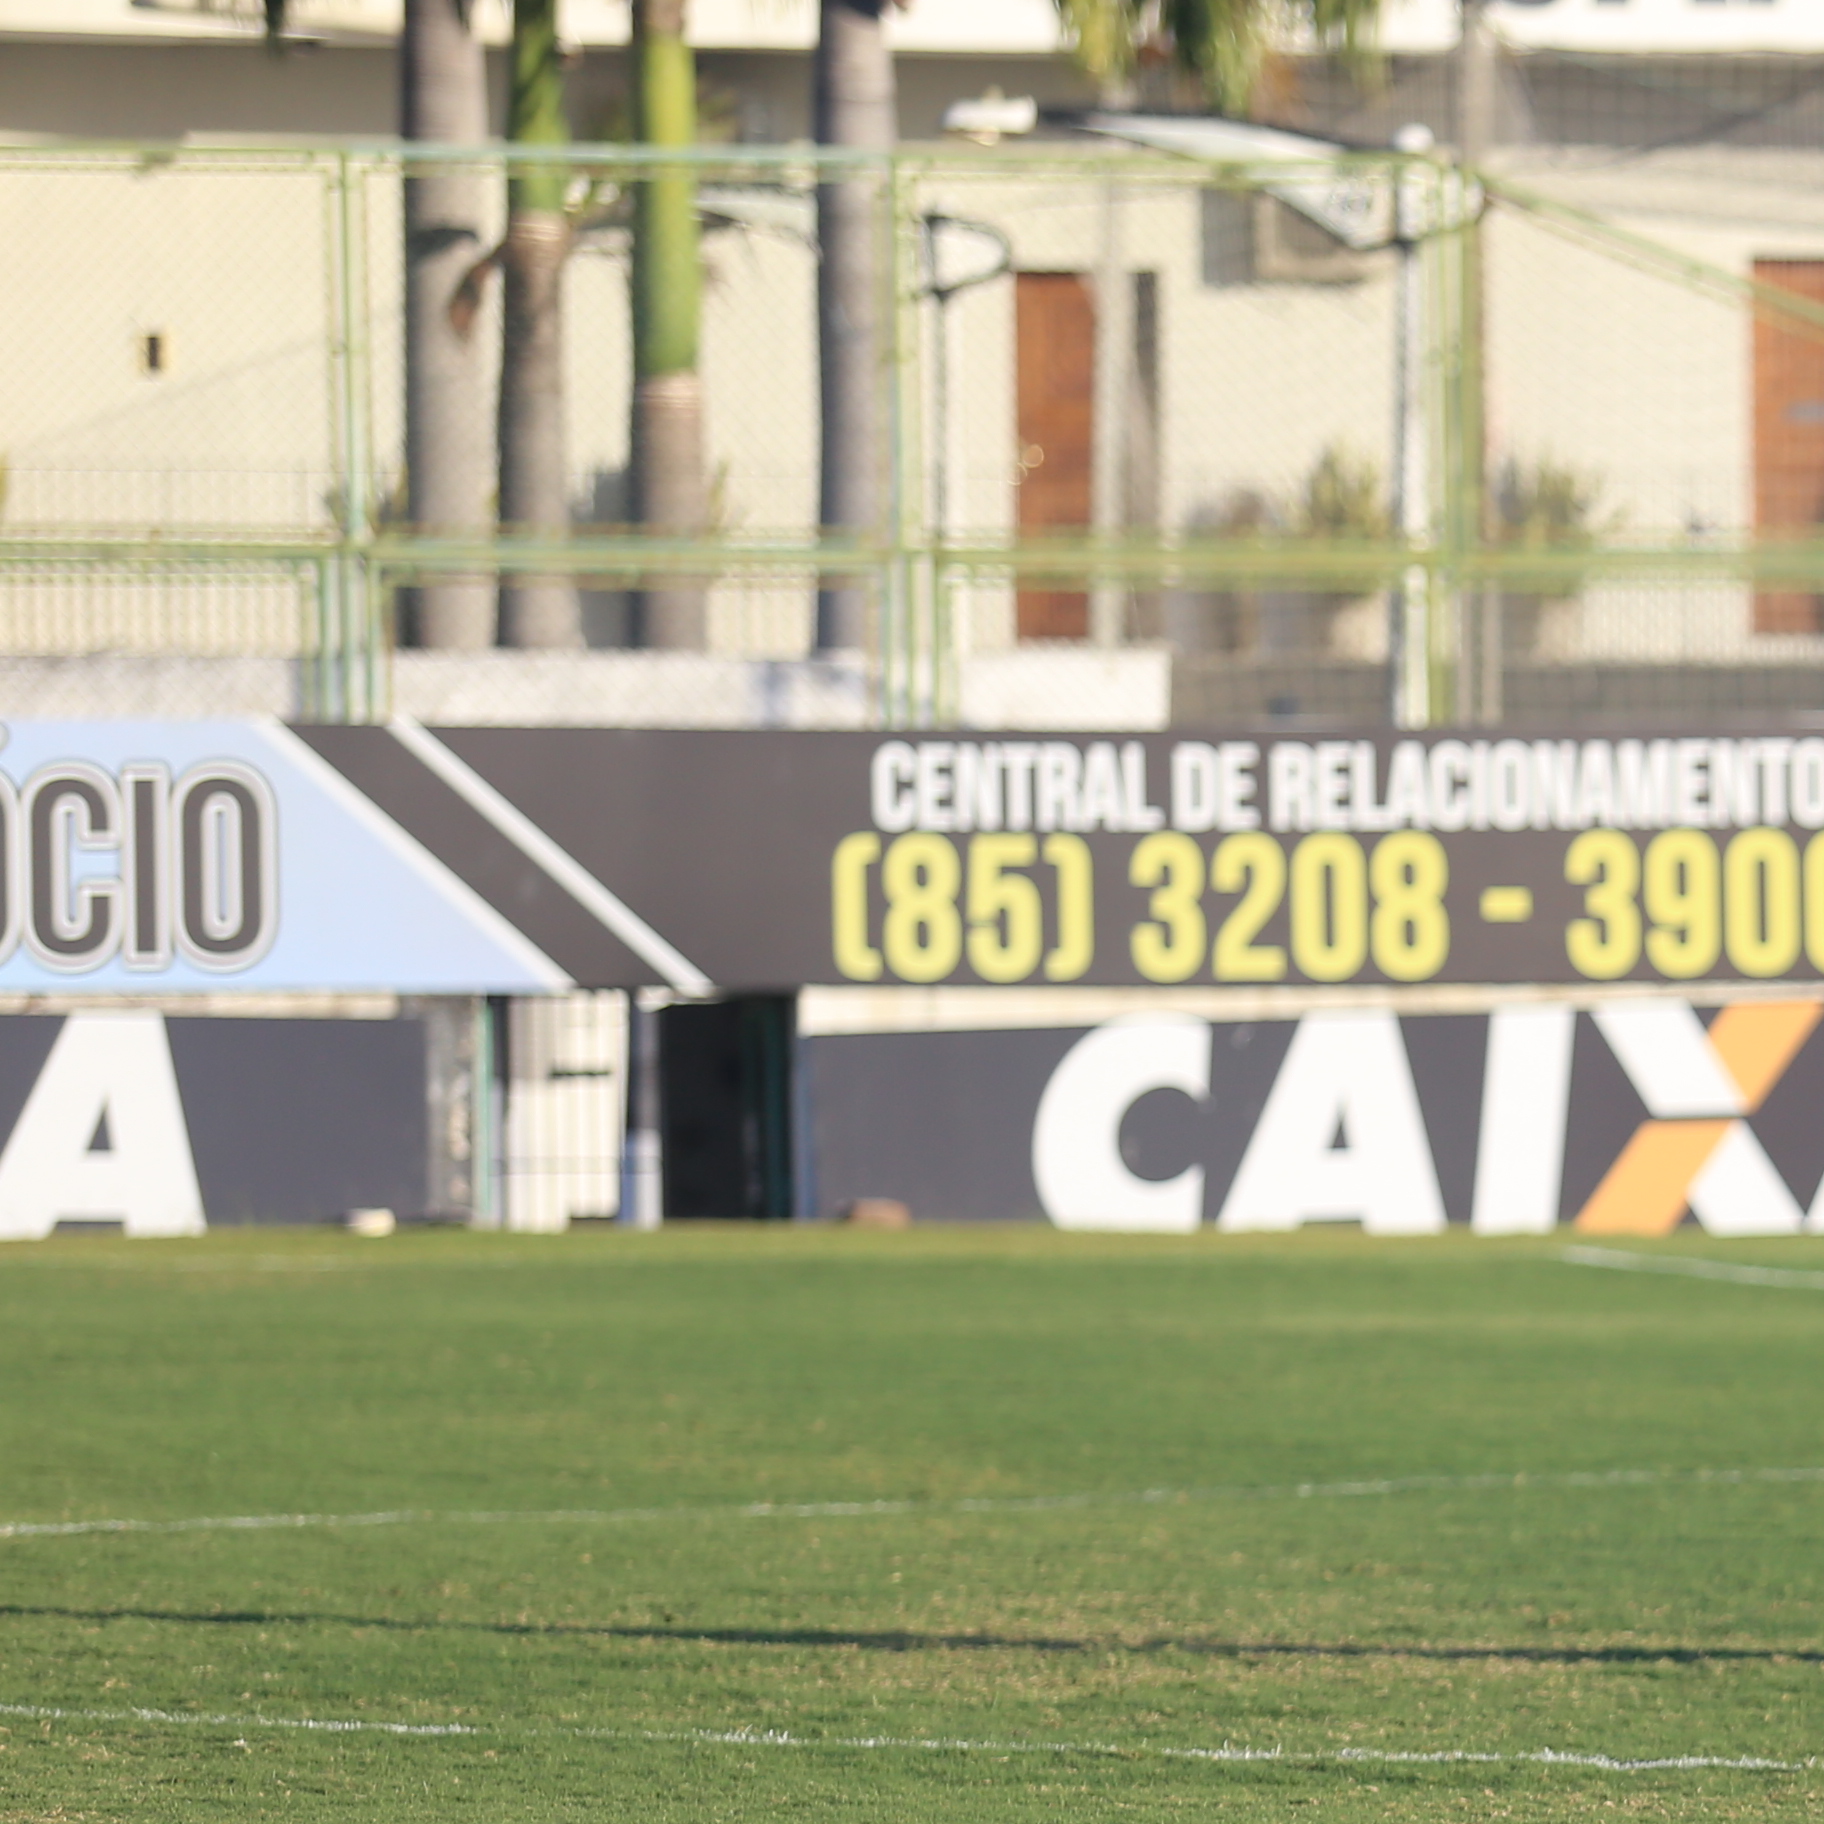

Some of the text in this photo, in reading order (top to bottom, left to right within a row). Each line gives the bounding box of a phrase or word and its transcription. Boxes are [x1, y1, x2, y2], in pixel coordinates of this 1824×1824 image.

[871, 740, 1168, 832] CENTRAL
[1171, 741, 1260, 831] DE
[0, 760, 278, 972] CIO
[831, 831, 1095, 983] (85)
[1129, 830, 1451, 983] 3208
